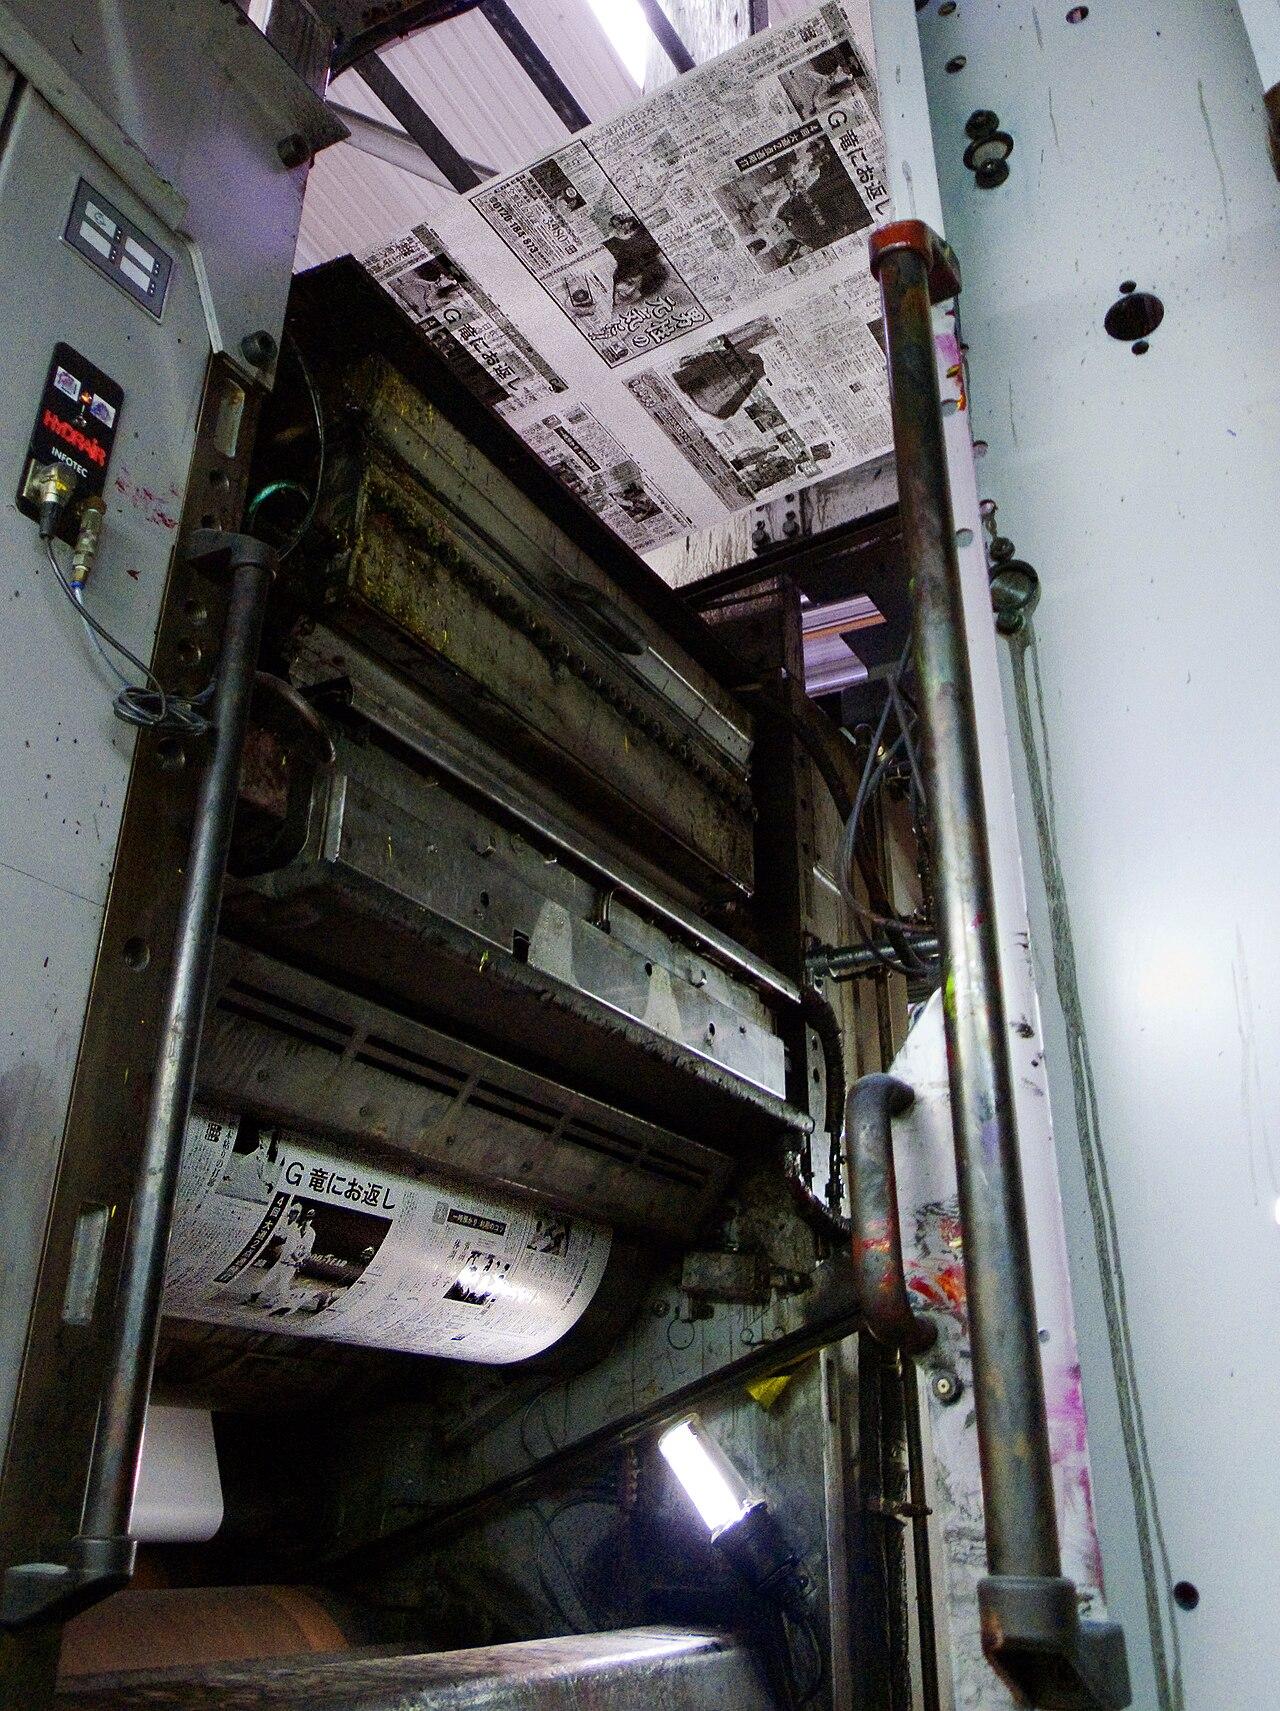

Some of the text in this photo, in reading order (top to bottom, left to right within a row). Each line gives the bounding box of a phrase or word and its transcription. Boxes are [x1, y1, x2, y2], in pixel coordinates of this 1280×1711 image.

[632, 306, 705, 345] 男性の
[51, 446, 88, 478] INFOTEC
